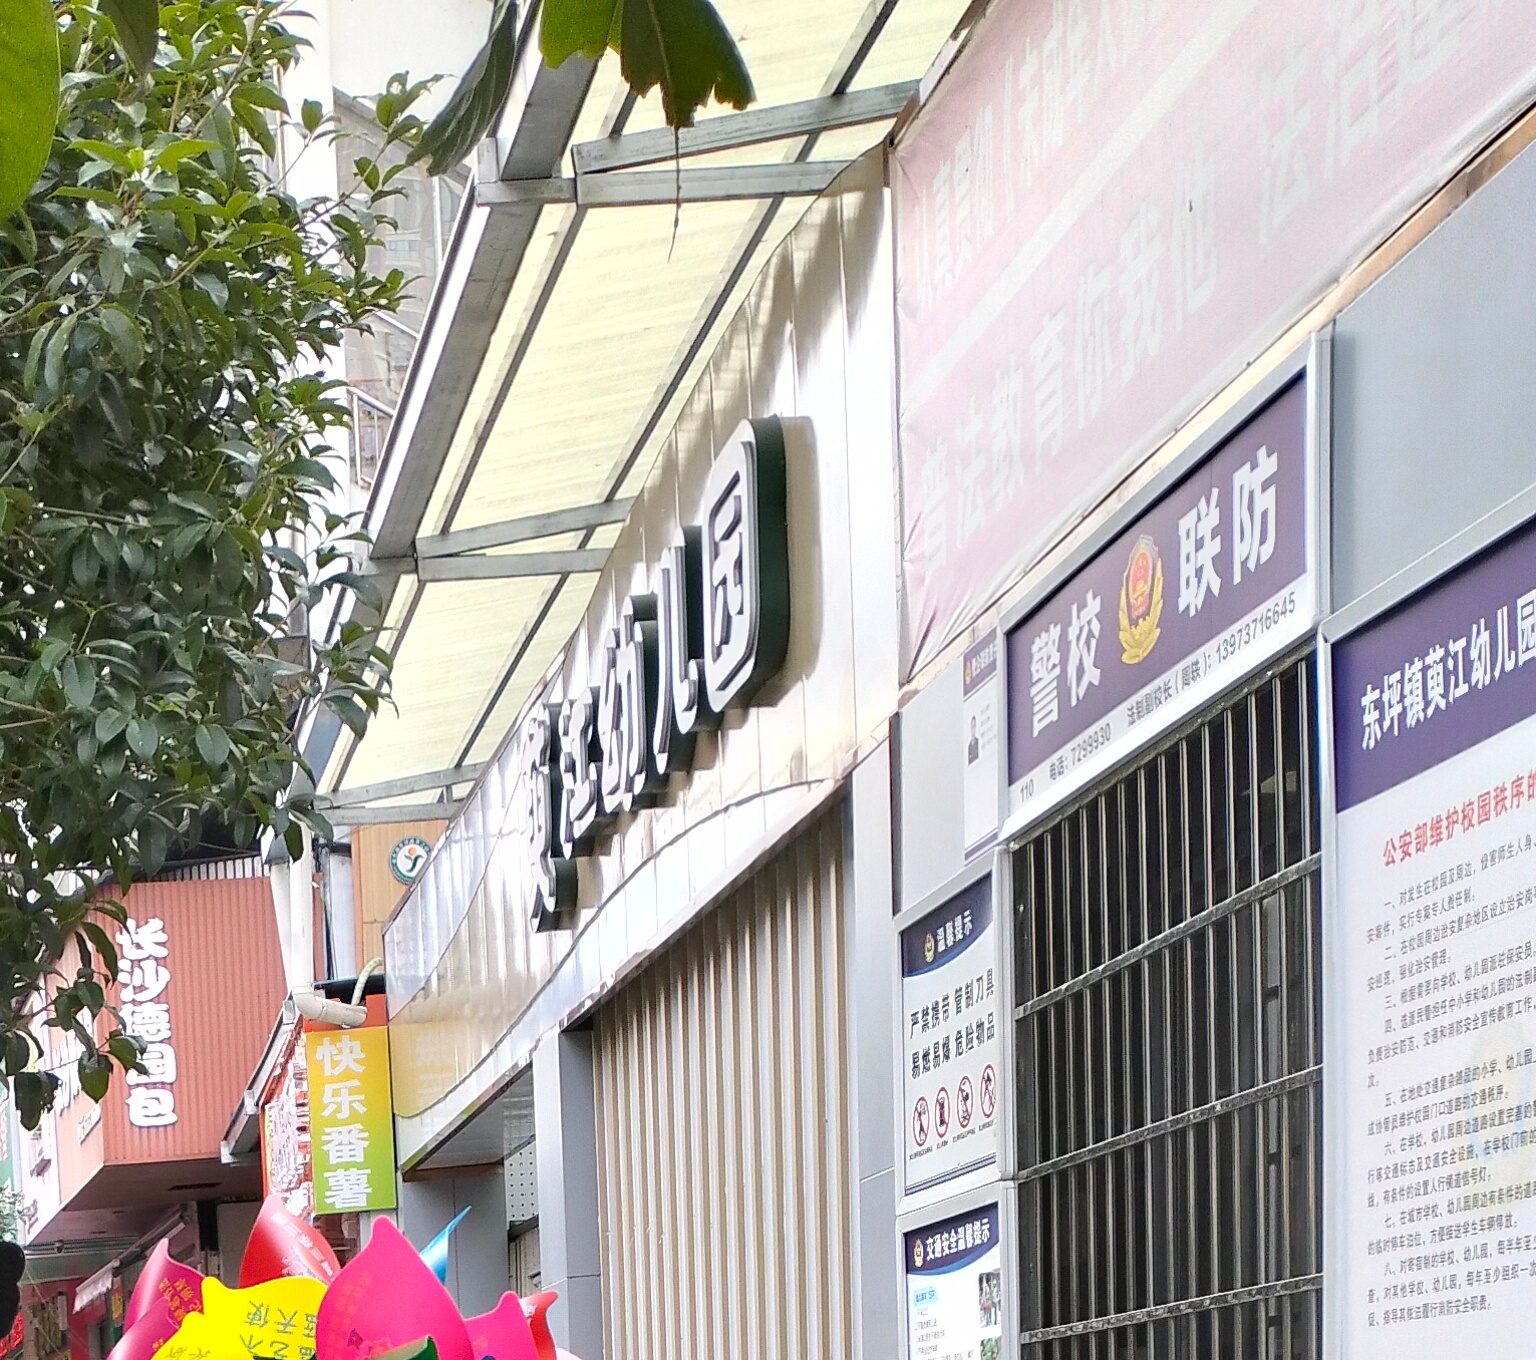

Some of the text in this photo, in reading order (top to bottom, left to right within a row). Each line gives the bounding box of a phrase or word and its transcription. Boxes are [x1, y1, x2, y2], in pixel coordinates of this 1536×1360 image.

[1030, 444, 1279, 738] 警校 联防
[1020, 780, 1034, 803] 110
[1215, 591, 1296, 664] 13973716645
[937, 909, 972, 953] 温馨提示
[910, 968, 994, 1039] 严禁携带 管制刀具
[911, 1012, 995, 1080] 易燃易爆 危险物品
[316, 1034, 372, 1209] 快乐番薯
[926, 1218, 991, 1262] 交通安全温馨提示
